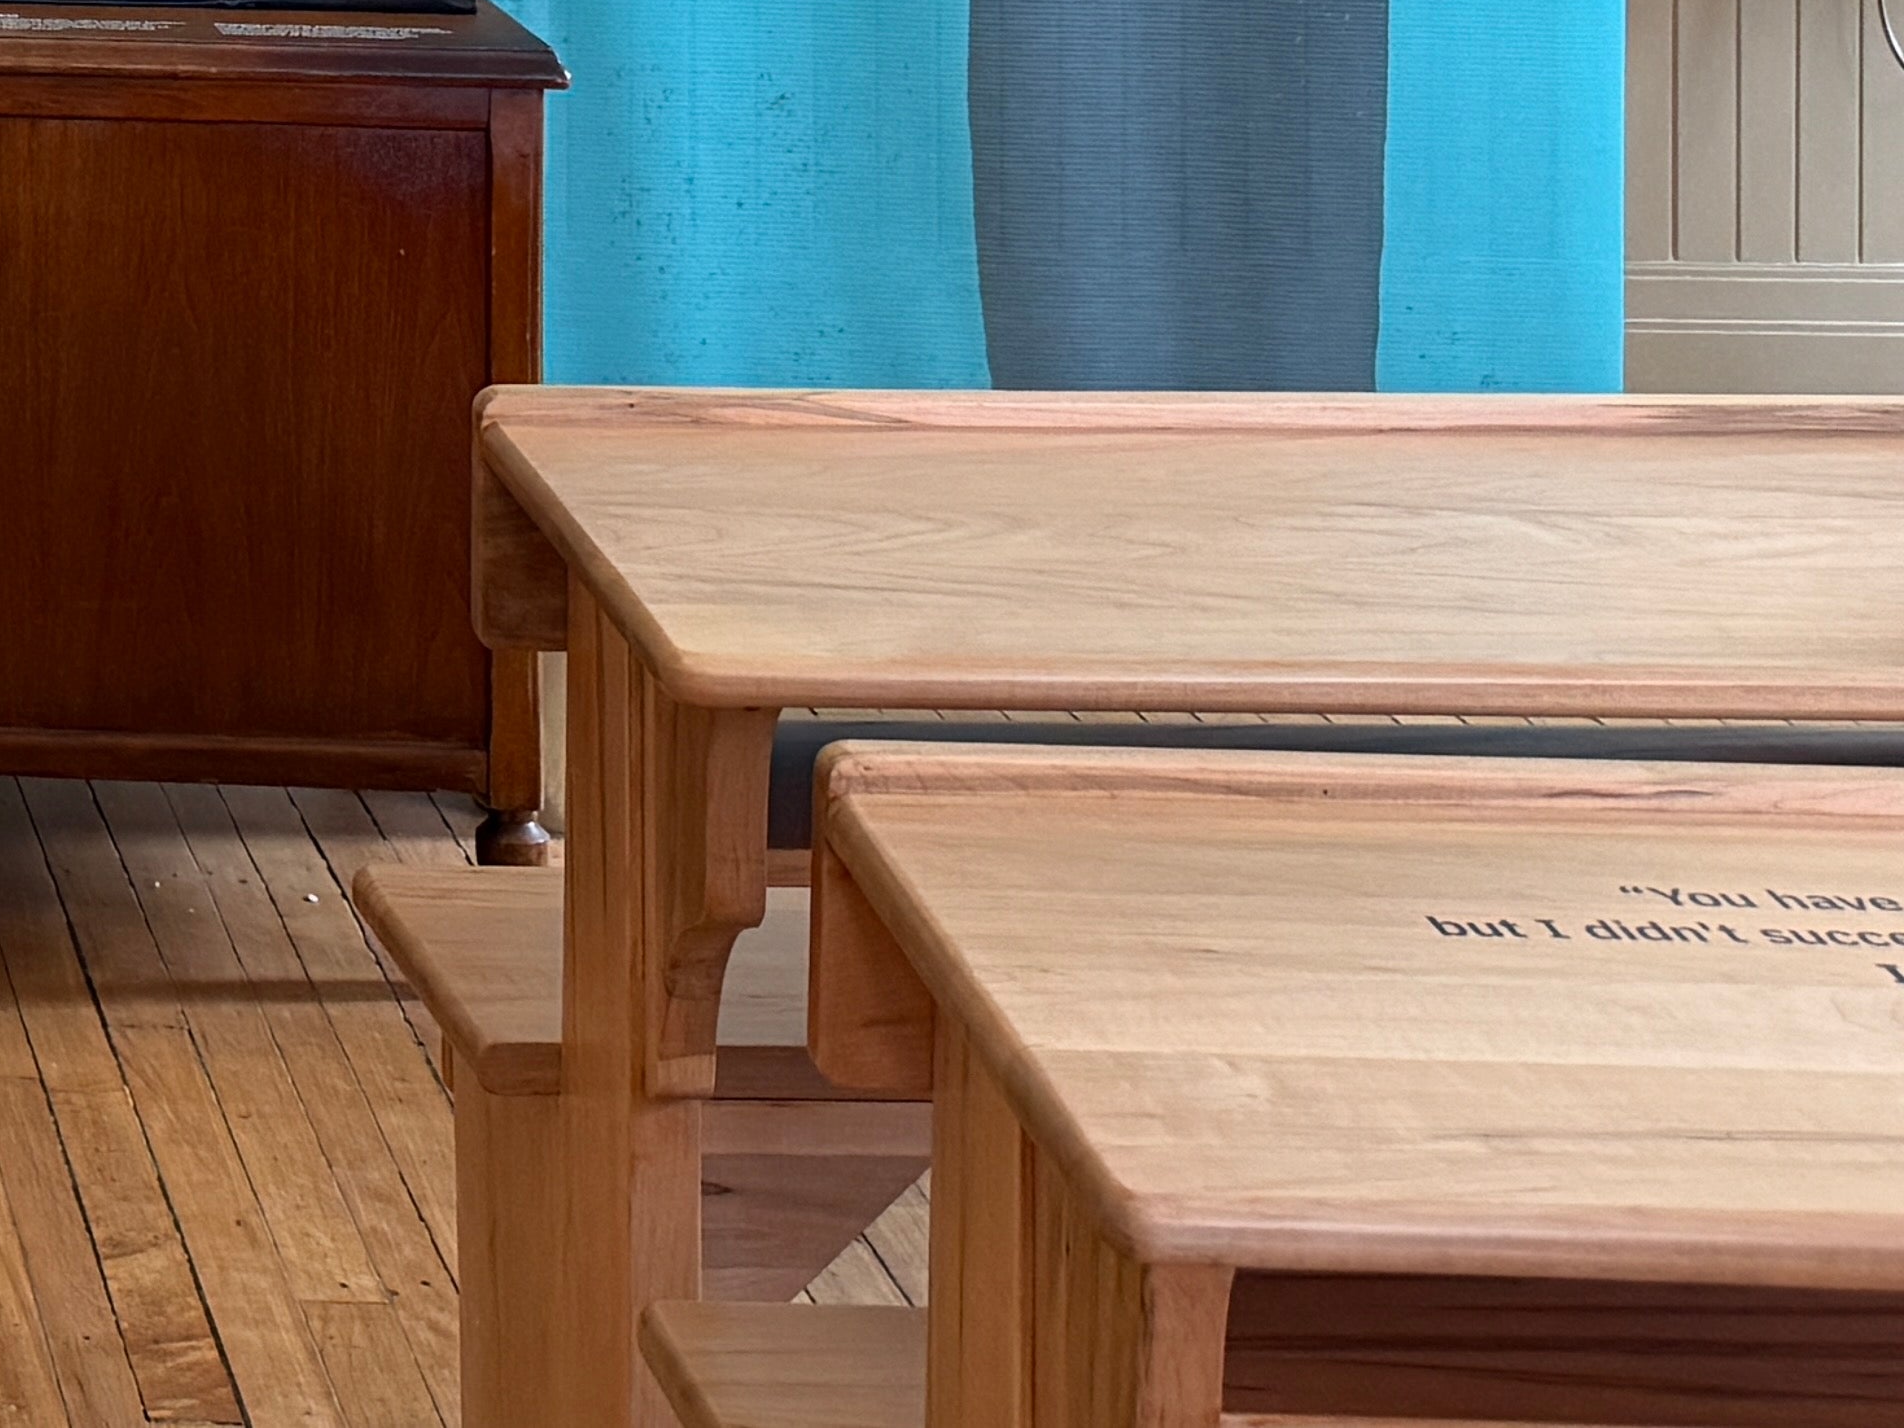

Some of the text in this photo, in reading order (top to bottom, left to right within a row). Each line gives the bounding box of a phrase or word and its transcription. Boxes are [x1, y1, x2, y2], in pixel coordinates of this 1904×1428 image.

[1424, 915, 1528, 939] but
[1533, 918, 1571, 940] I
[1584, 919, 1749, 943] didn't
